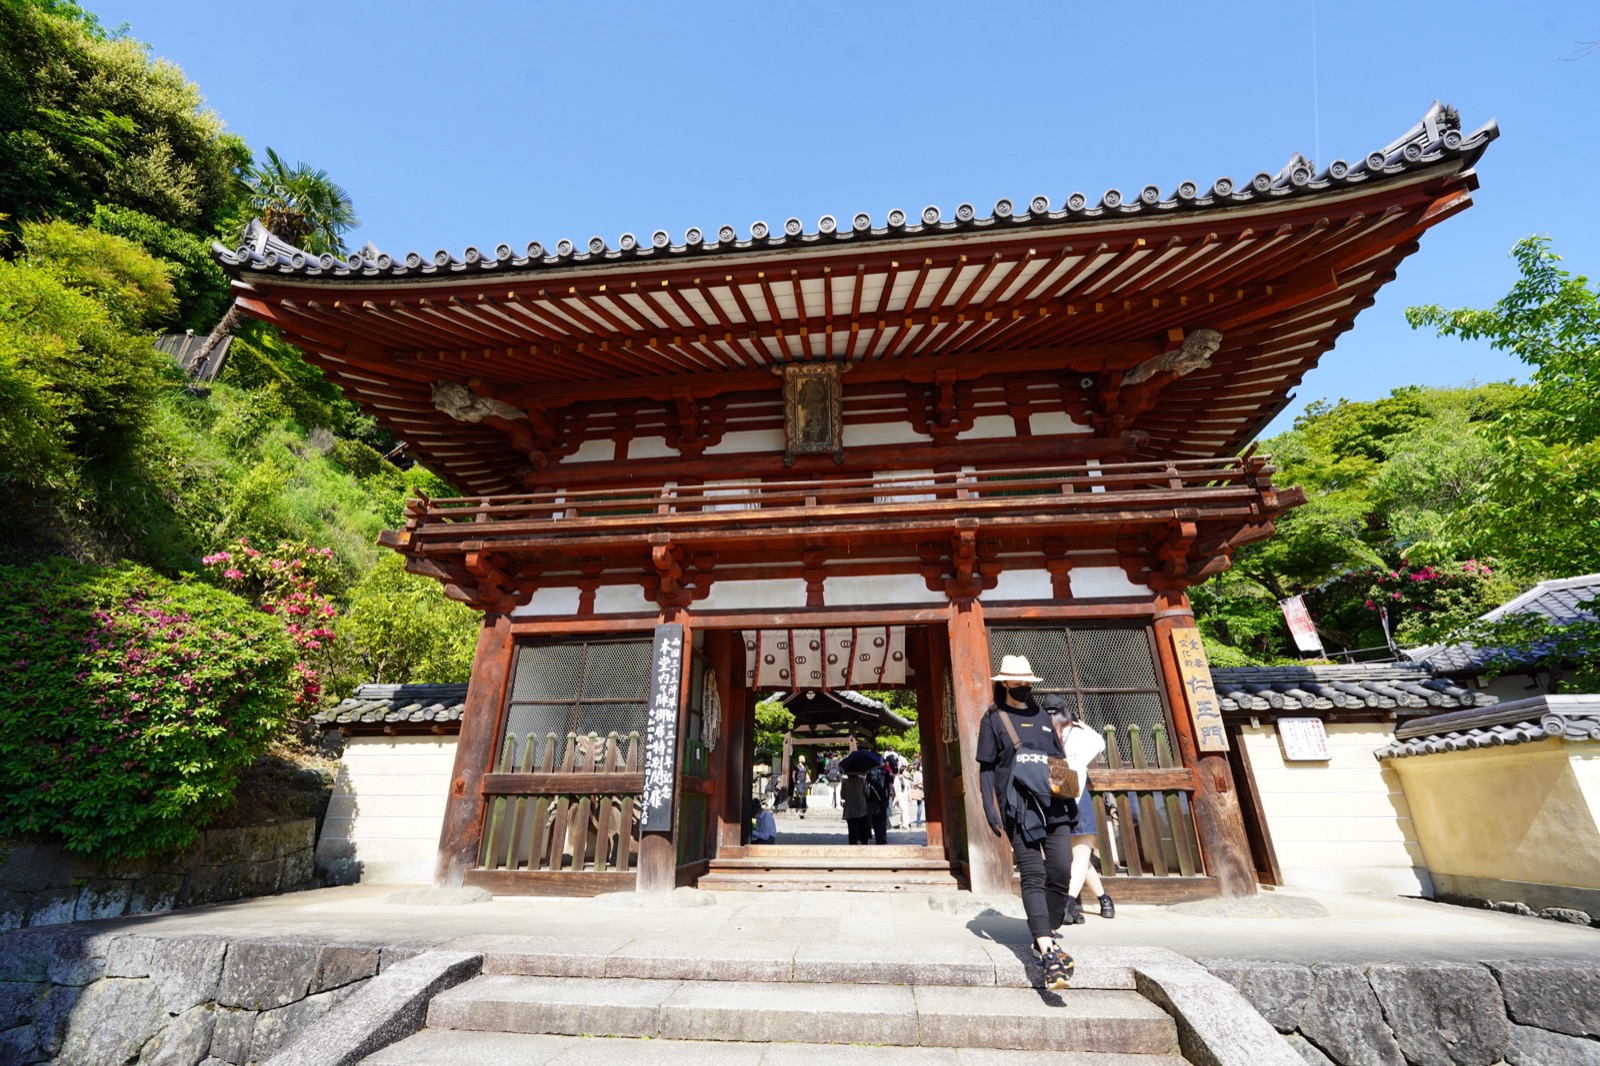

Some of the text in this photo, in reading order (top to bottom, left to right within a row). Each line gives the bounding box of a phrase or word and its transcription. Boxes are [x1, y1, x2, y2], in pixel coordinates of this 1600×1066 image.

[1178, 639, 1194, 667] 文化財
[1189, 639, 1205, 668] 重要
[1185, 674, 1226, 746] 仁王門
